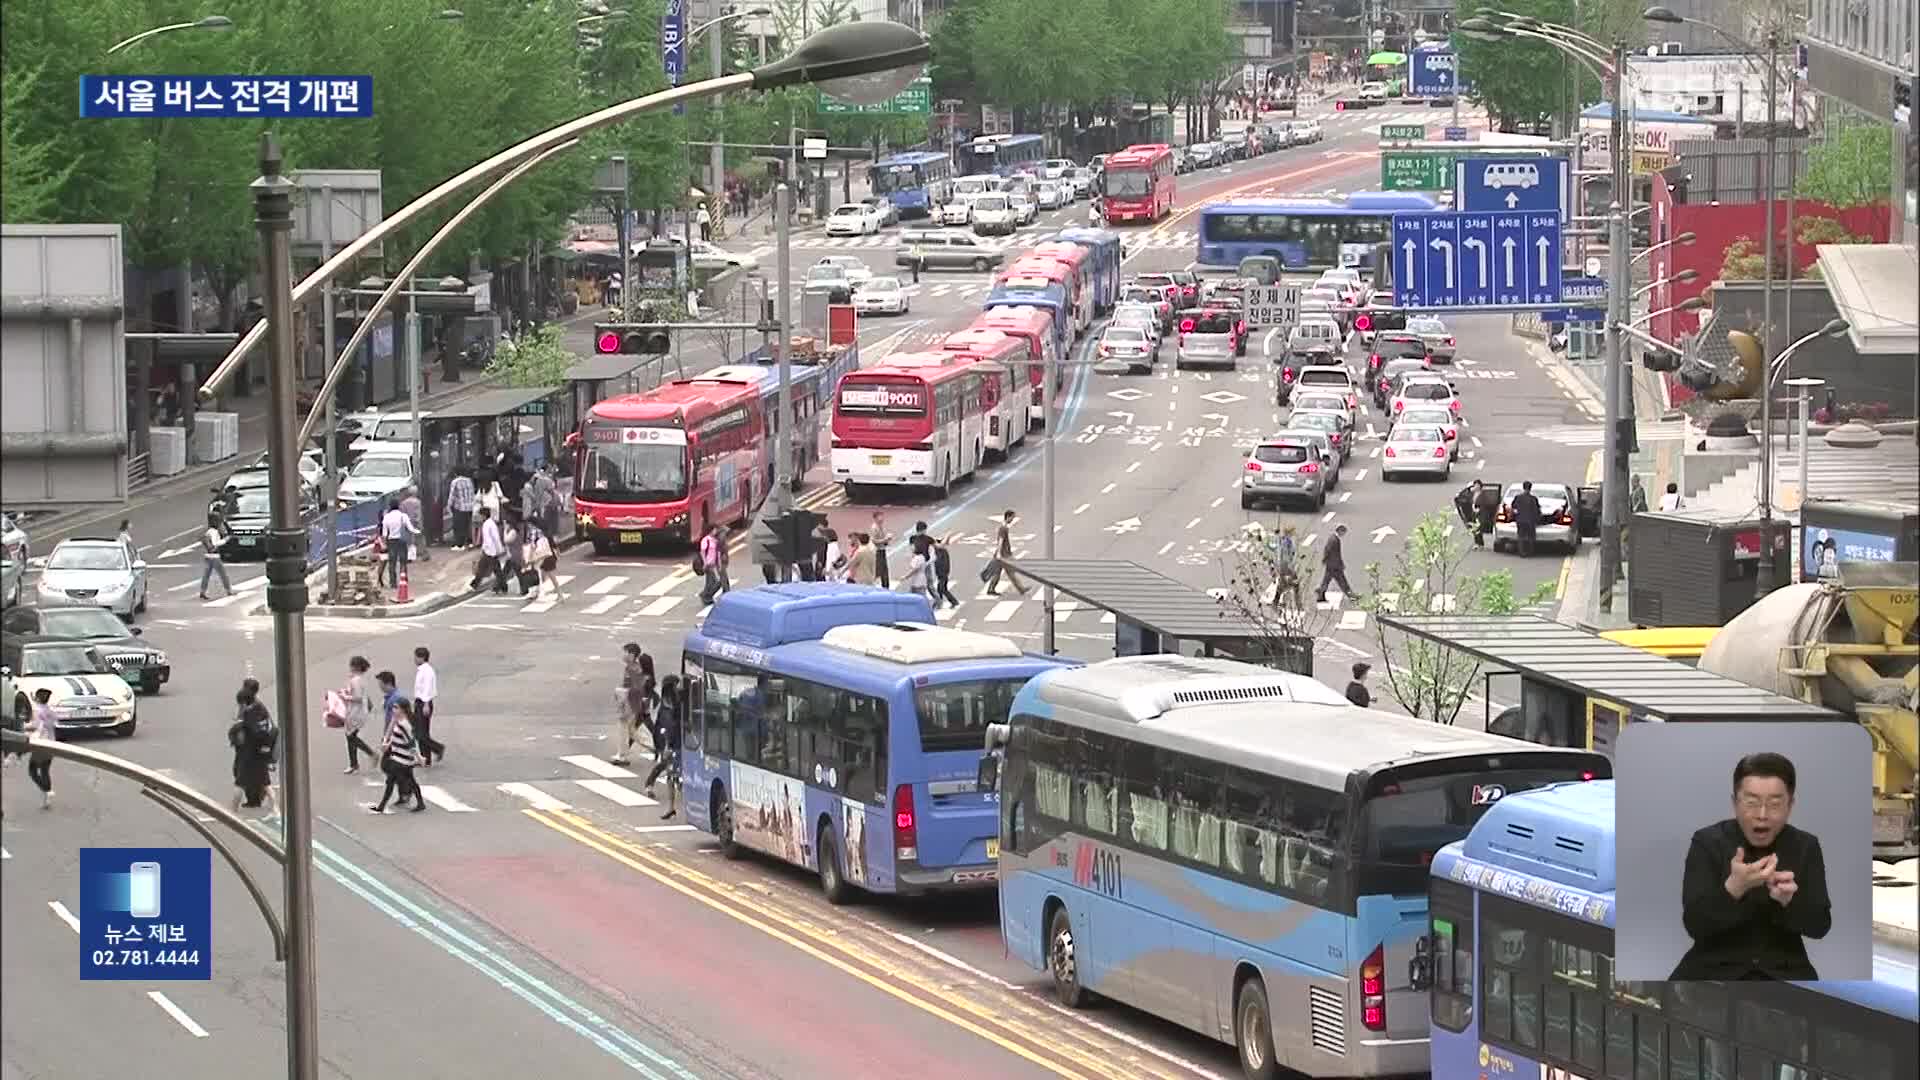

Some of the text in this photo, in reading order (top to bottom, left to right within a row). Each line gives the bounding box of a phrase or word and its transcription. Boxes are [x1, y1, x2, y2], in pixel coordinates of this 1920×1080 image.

[664, 24, 678, 55] IBK
[1399, 221, 1420, 230] 1차로
[1431, 220, 1455, 230] 2차로
[1465, 219, 1488, 229] 3차로
[1498, 218, 1521, 228] 4차로
[1532, 217, 1555, 227] 5차로
[1249, 307, 1296, 324] 진입금지
[889, 392, 919, 406] 9001
[593, 431, 618, 441] 9401
